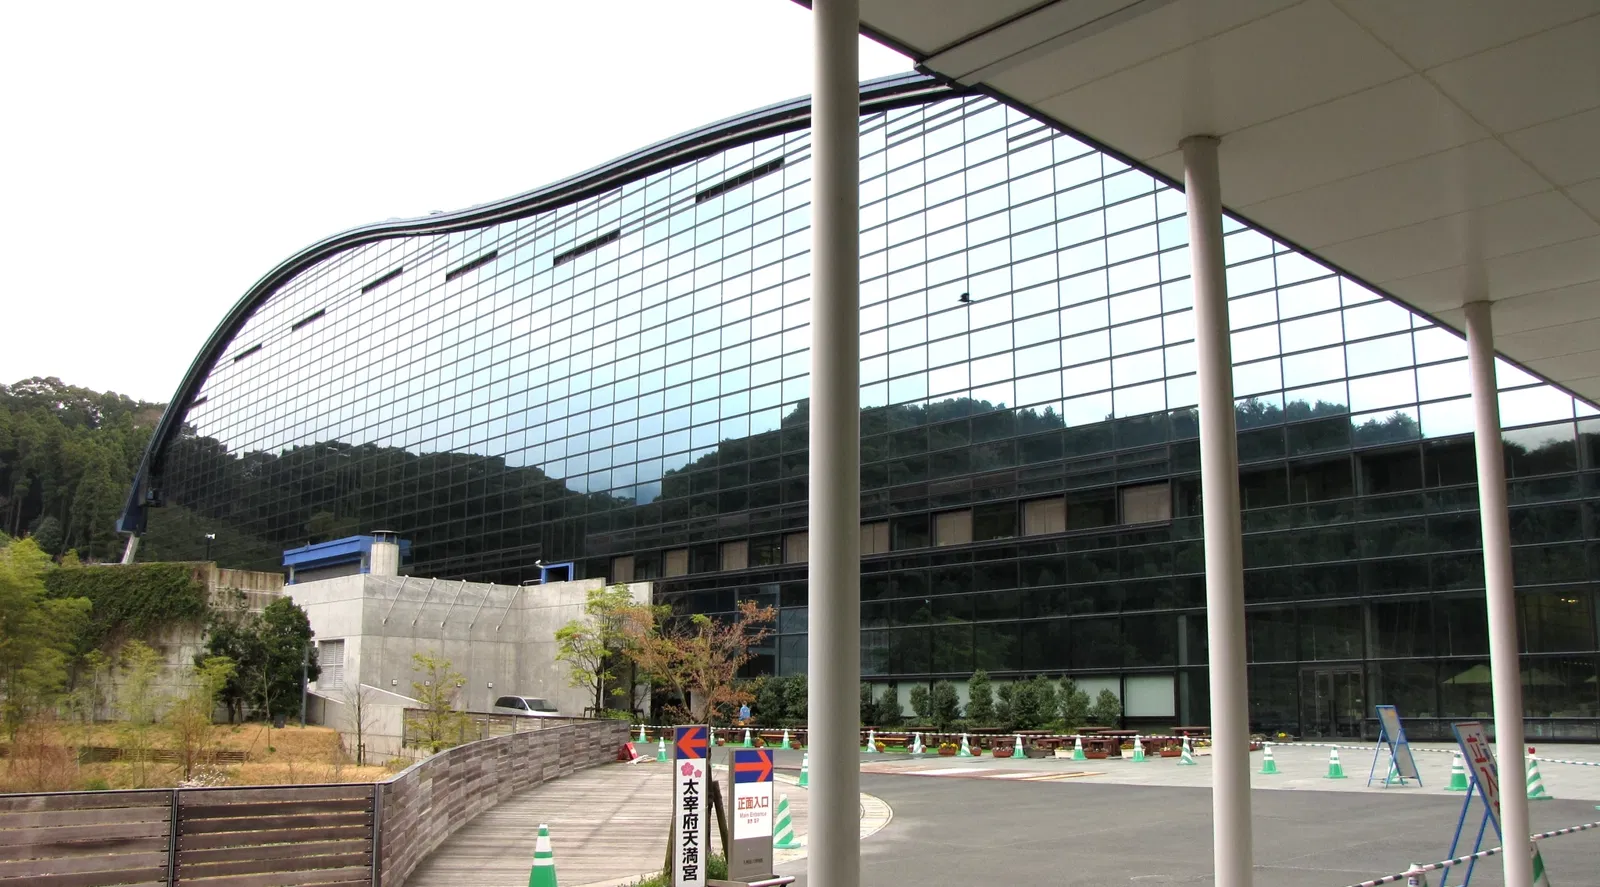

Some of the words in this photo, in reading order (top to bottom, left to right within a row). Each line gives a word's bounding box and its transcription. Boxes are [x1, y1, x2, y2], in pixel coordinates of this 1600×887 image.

[682, 779, 699, 881] 太宰府天満宮
[737, 796, 769, 810] 正面入口
